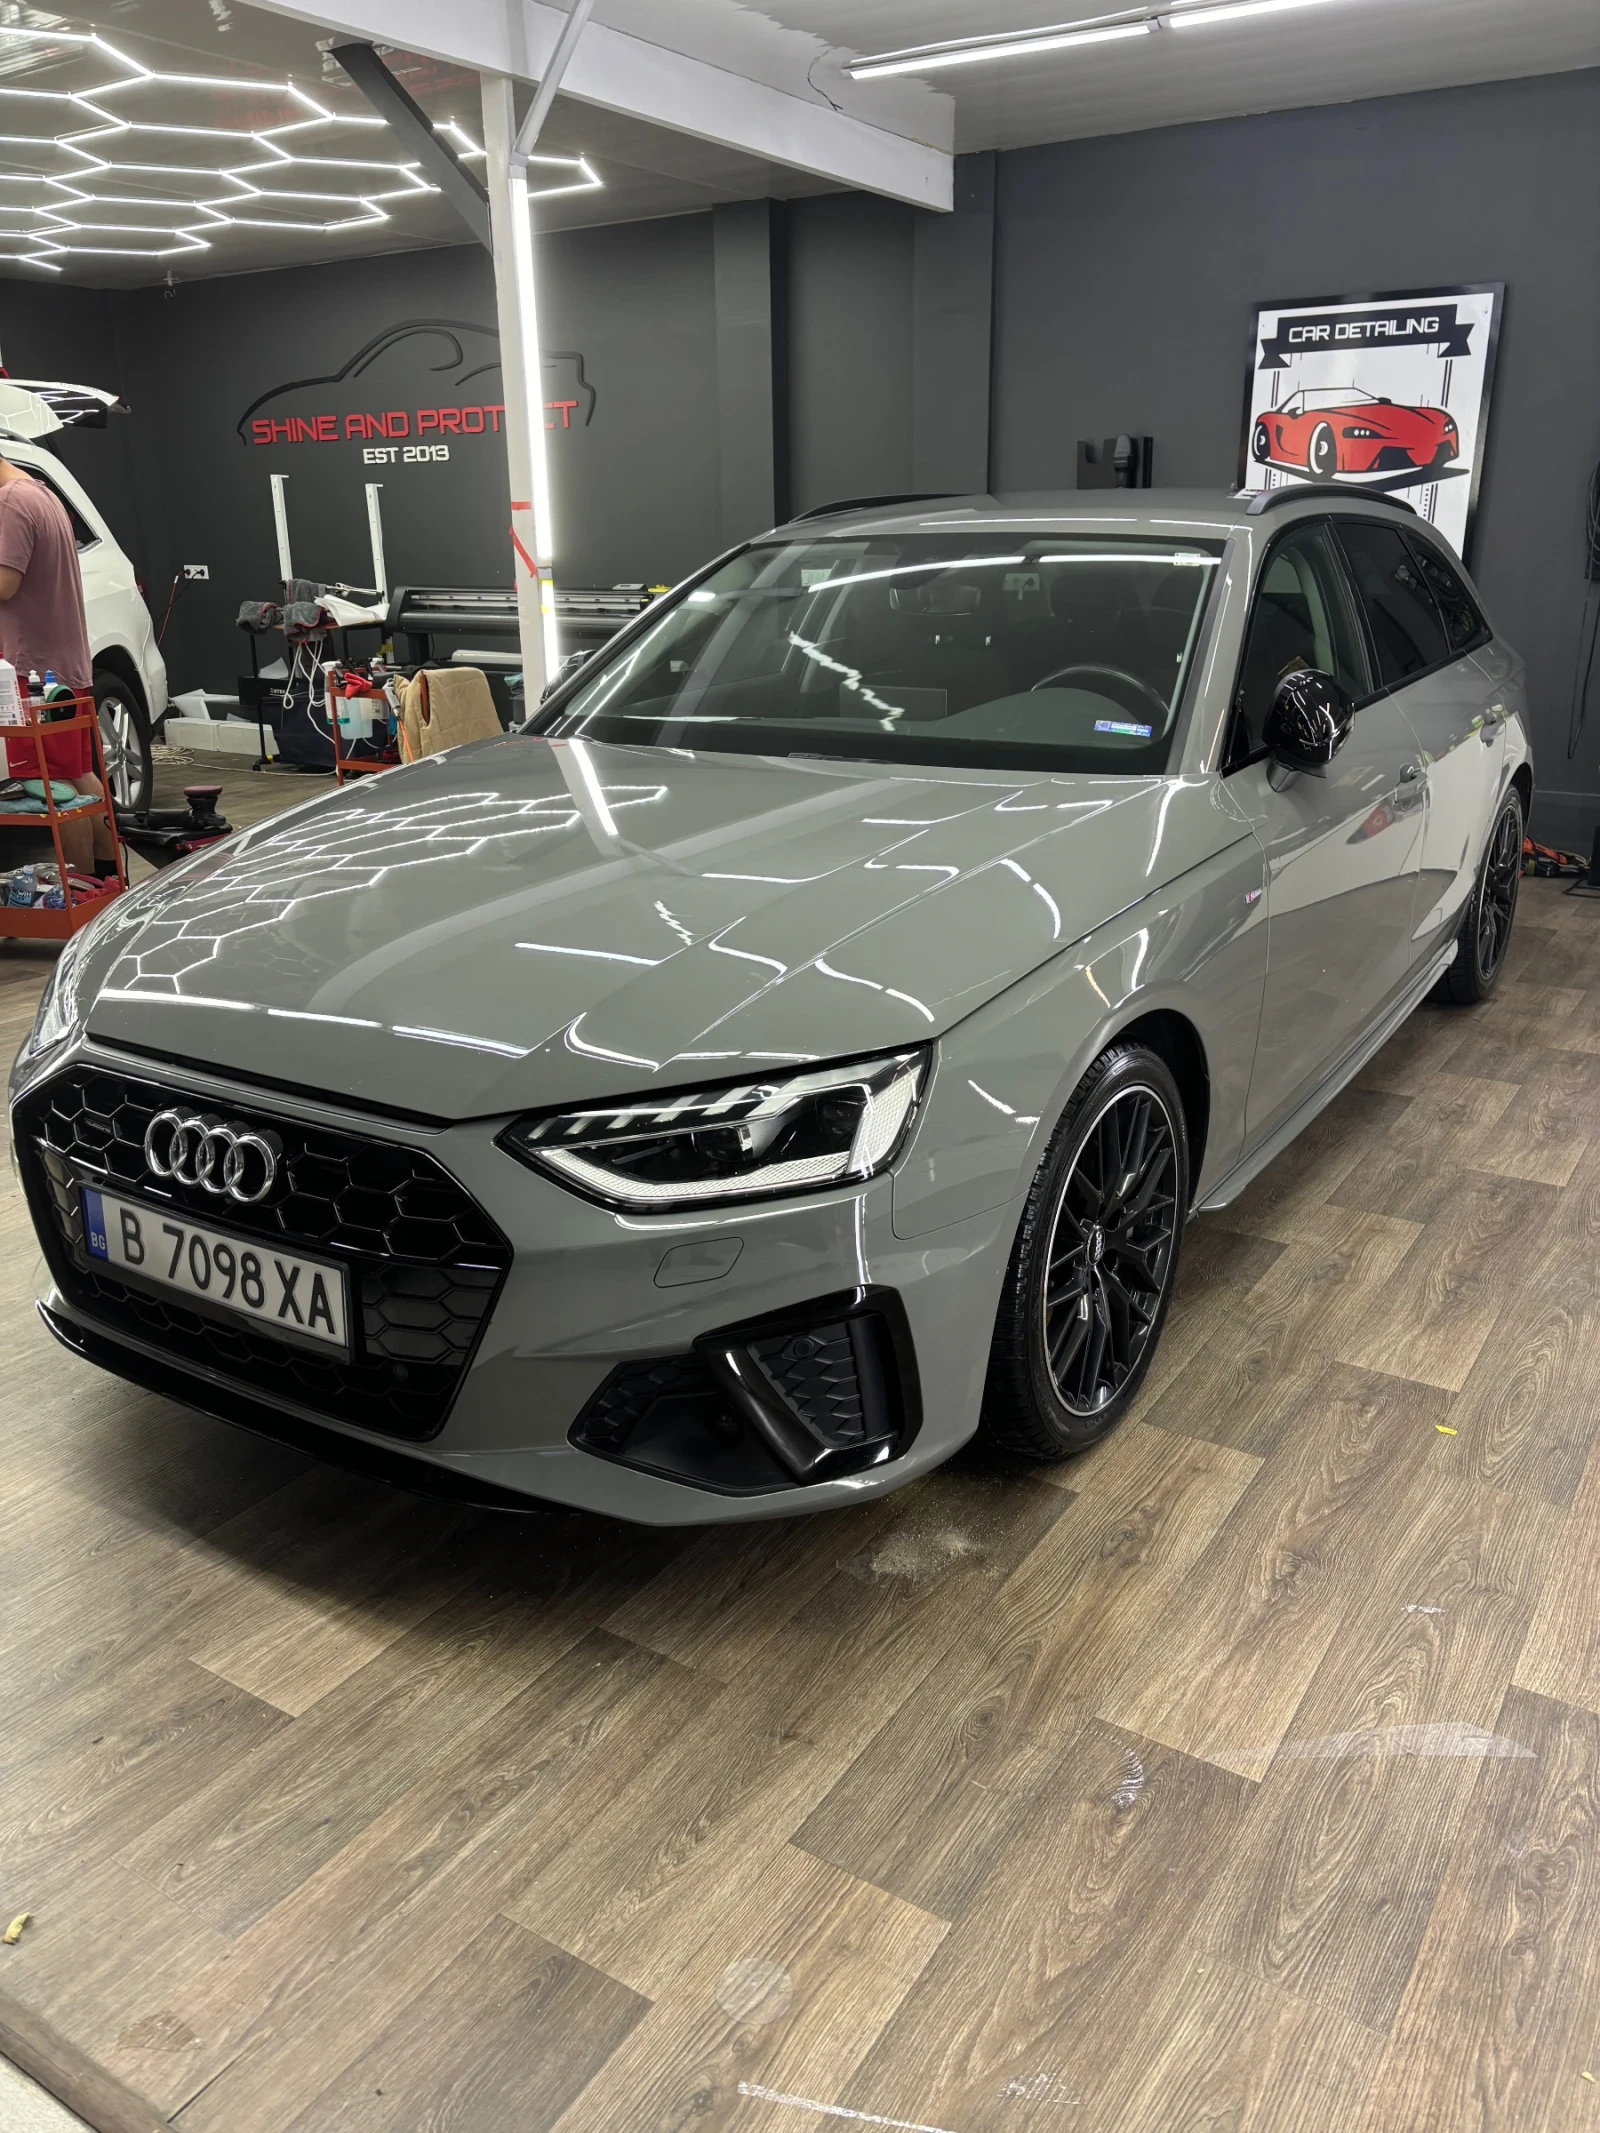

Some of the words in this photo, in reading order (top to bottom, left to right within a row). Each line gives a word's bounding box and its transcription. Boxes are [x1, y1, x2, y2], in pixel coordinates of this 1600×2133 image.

[1289, 324, 1331, 343] CAR
[1335, 316, 1440, 340] DETAILING
[251, 415, 340, 445] SHINE
[344, 411, 410, 440] AND
[416, 400, 579, 436] PROTT
[362, 446, 400, 465] EST
[402, 444, 450, 463] 2013
[90, 1231, 106, 1250] BG
[119, 1207, 145, 1266] B
[162, 1222, 266, 1309] 7098
[273, 1259, 337, 1335] XA
